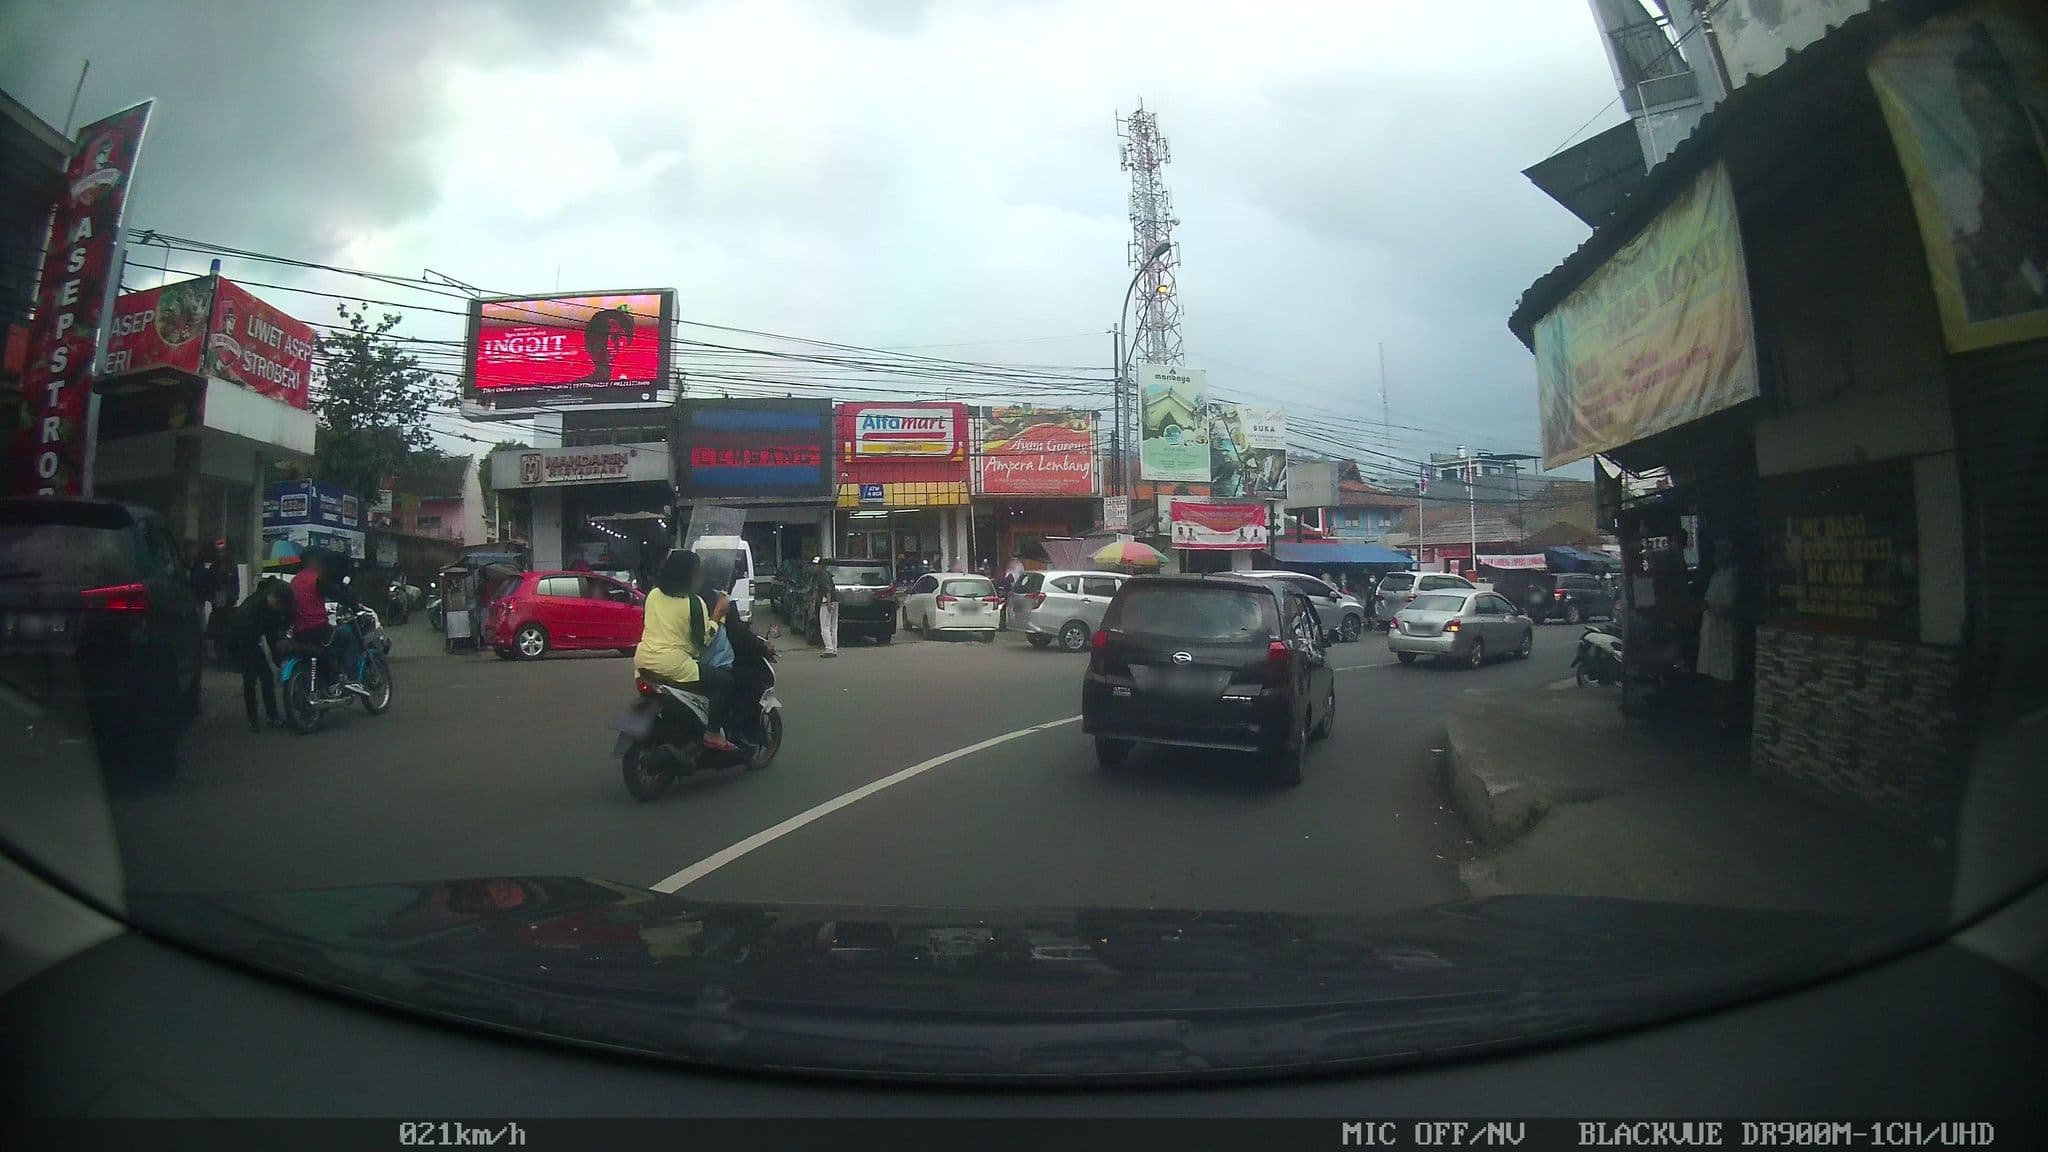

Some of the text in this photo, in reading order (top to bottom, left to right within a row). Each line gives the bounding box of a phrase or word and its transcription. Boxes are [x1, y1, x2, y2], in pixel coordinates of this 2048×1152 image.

[111, 310, 155, 337] ASEP
[248, 314, 285, 350] LIWET
[284, 334, 312, 362] ASEP
[242, 350, 301, 390] STROBERI
[1154, 373, 1191, 384] maribaya
[862, 414, 946, 431] Alfamart
[1252, 425, 1276, 433] BUKA
[1009, 438, 1090, 455] Ayam Goreng
[545, 452, 629, 469] MANDARIN
[698, 448, 813, 465] LEMBANG
[984, 454, 1091, 480] Ampera Lembang
